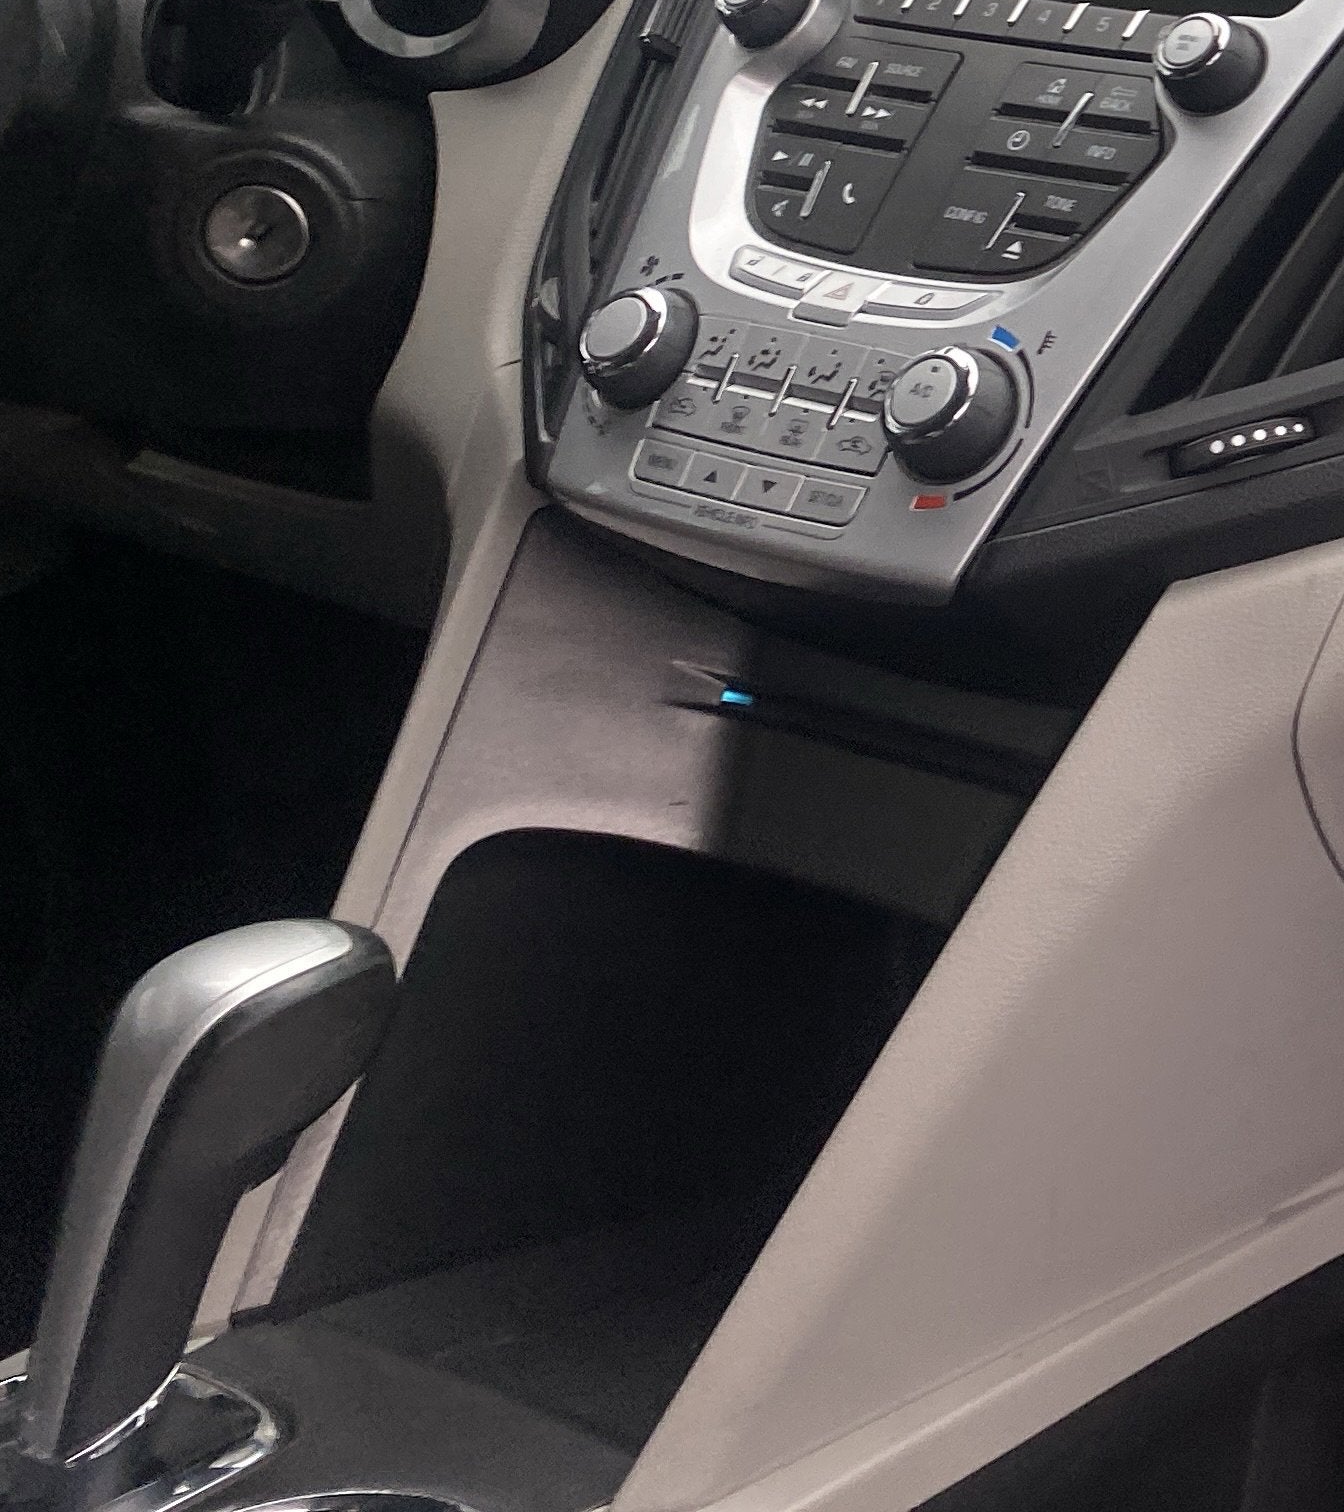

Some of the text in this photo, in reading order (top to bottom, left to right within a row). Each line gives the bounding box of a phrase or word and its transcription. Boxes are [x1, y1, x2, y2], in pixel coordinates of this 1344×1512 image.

[983, 2, 999, 18] 3
[1036, 9, 1052, 23] 4
[1095, 16, 1113, 33] 5
